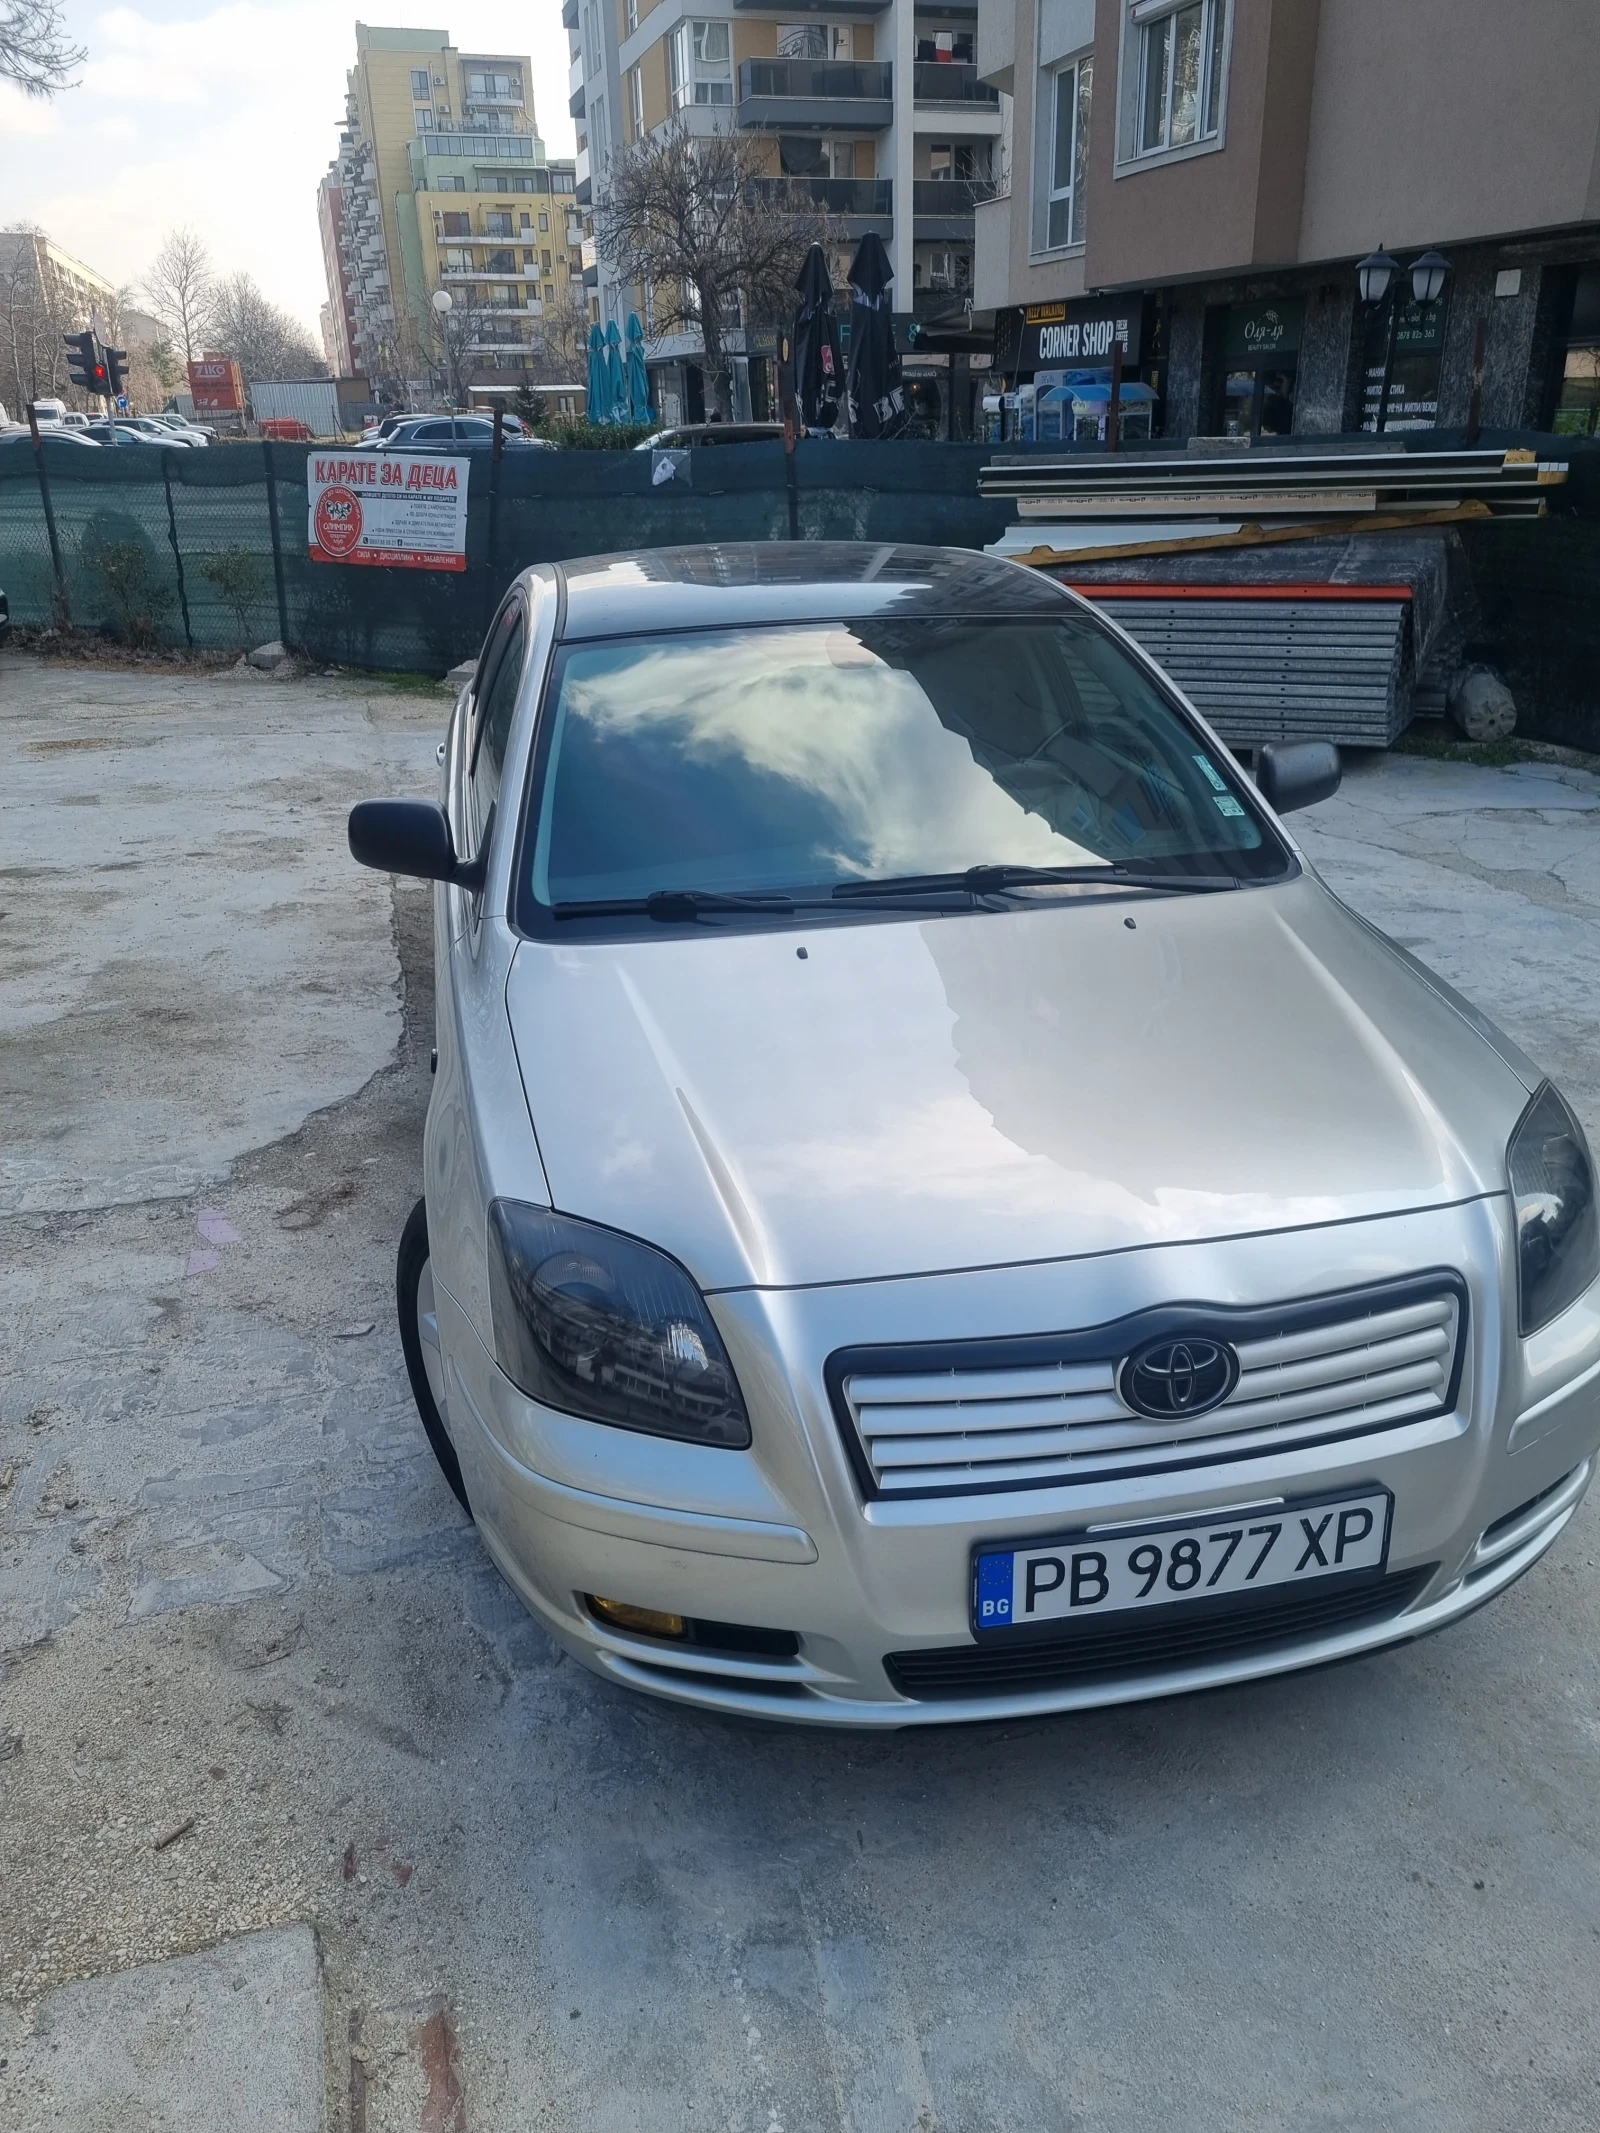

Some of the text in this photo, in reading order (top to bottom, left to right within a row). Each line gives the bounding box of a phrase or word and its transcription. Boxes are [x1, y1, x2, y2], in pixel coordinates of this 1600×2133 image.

[1116, 319, 1128, 330] FRESH
[1039, 320, 1114, 360] CORNER SHOP
[1115, 330, 1129, 341] COFFEE
[315, 460, 459, 491] КАРАТЕ ЗА ДЕЦА
[323, 523, 354, 531] ОЛИМПИК
[357, 550, 456, 564] СИЛА ДИСЦИПЛИНА ЗАБАВЛЕНИЕ
[1025, 1507, 1374, 1613] PB 9877 XP
[982, 1598, 1010, 1617] BG
